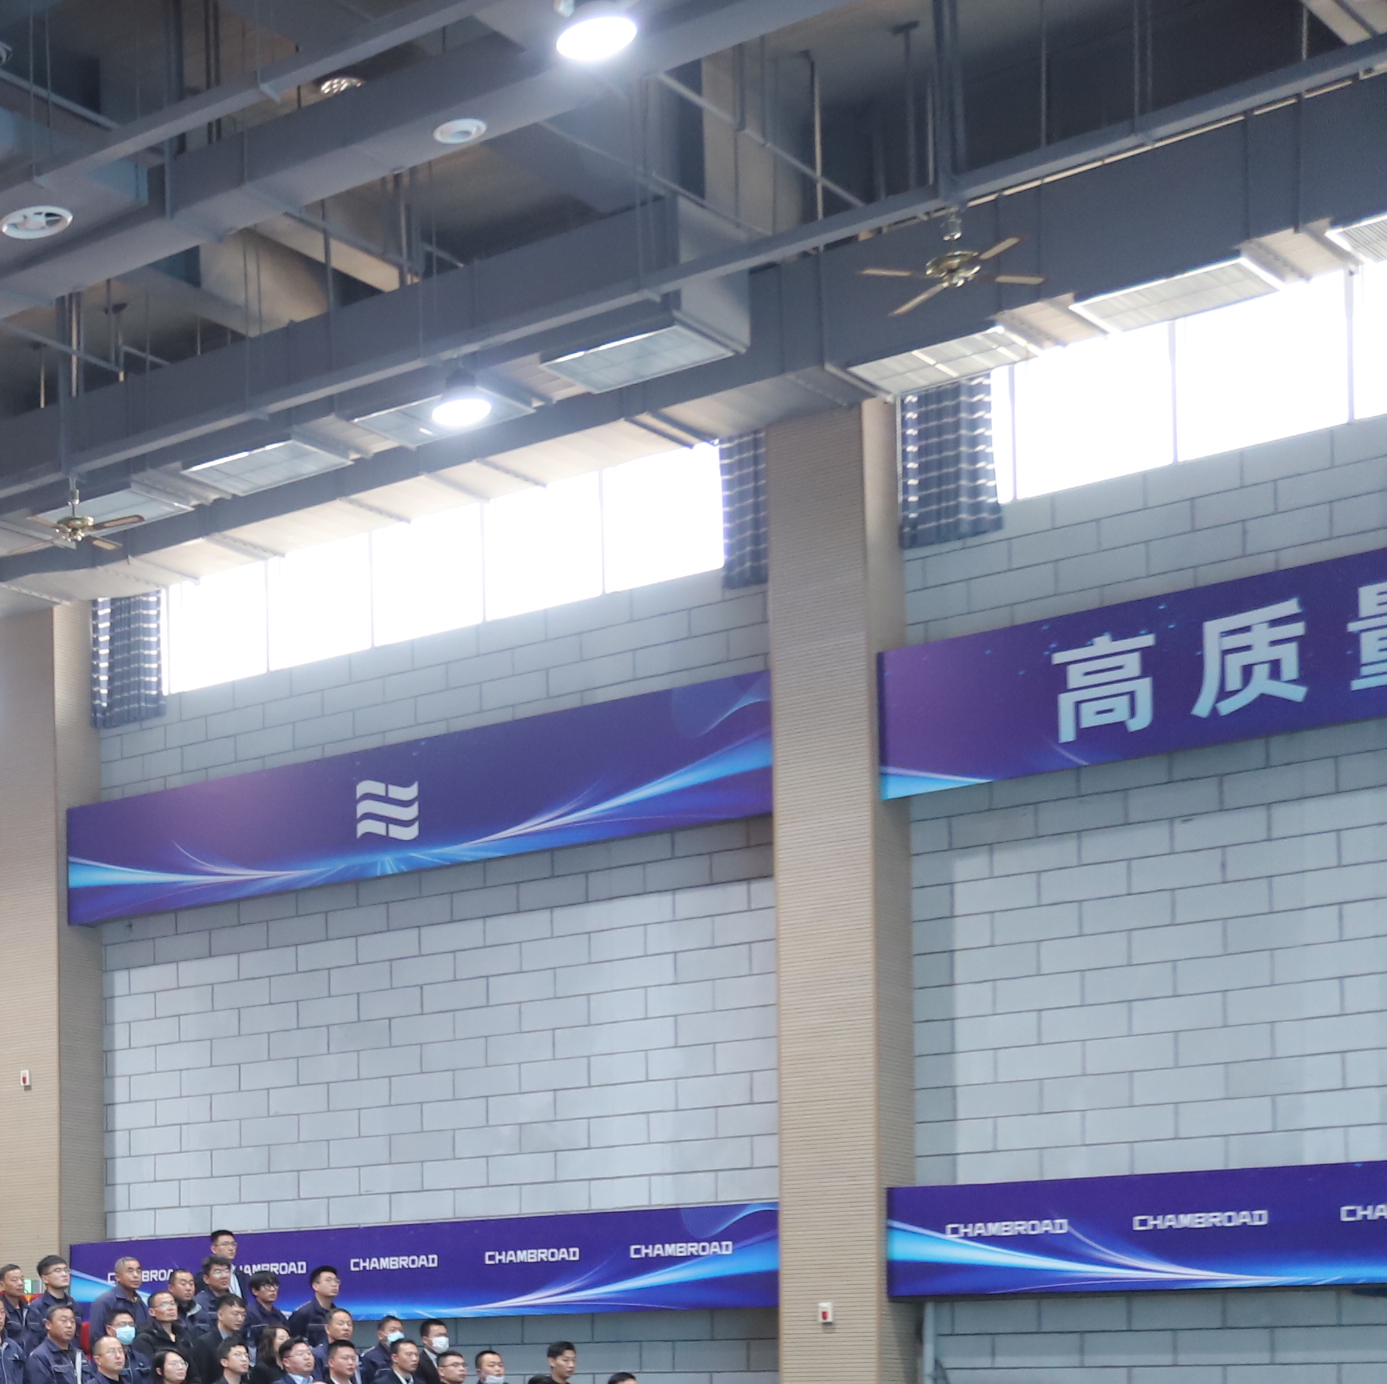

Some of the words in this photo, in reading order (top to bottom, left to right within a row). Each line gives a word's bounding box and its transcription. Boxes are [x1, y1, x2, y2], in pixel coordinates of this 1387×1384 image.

[946, 1219, 1068, 1239] CHAMBROAD
[1133, 1210, 1268, 1231] CHAMBROAD
[485, 1247, 579, 1264] CHAMBROAD
[630, 1240, 732, 1258] CHAMBROAD
[350, 1254, 437, 1271] CHAMBROAD
